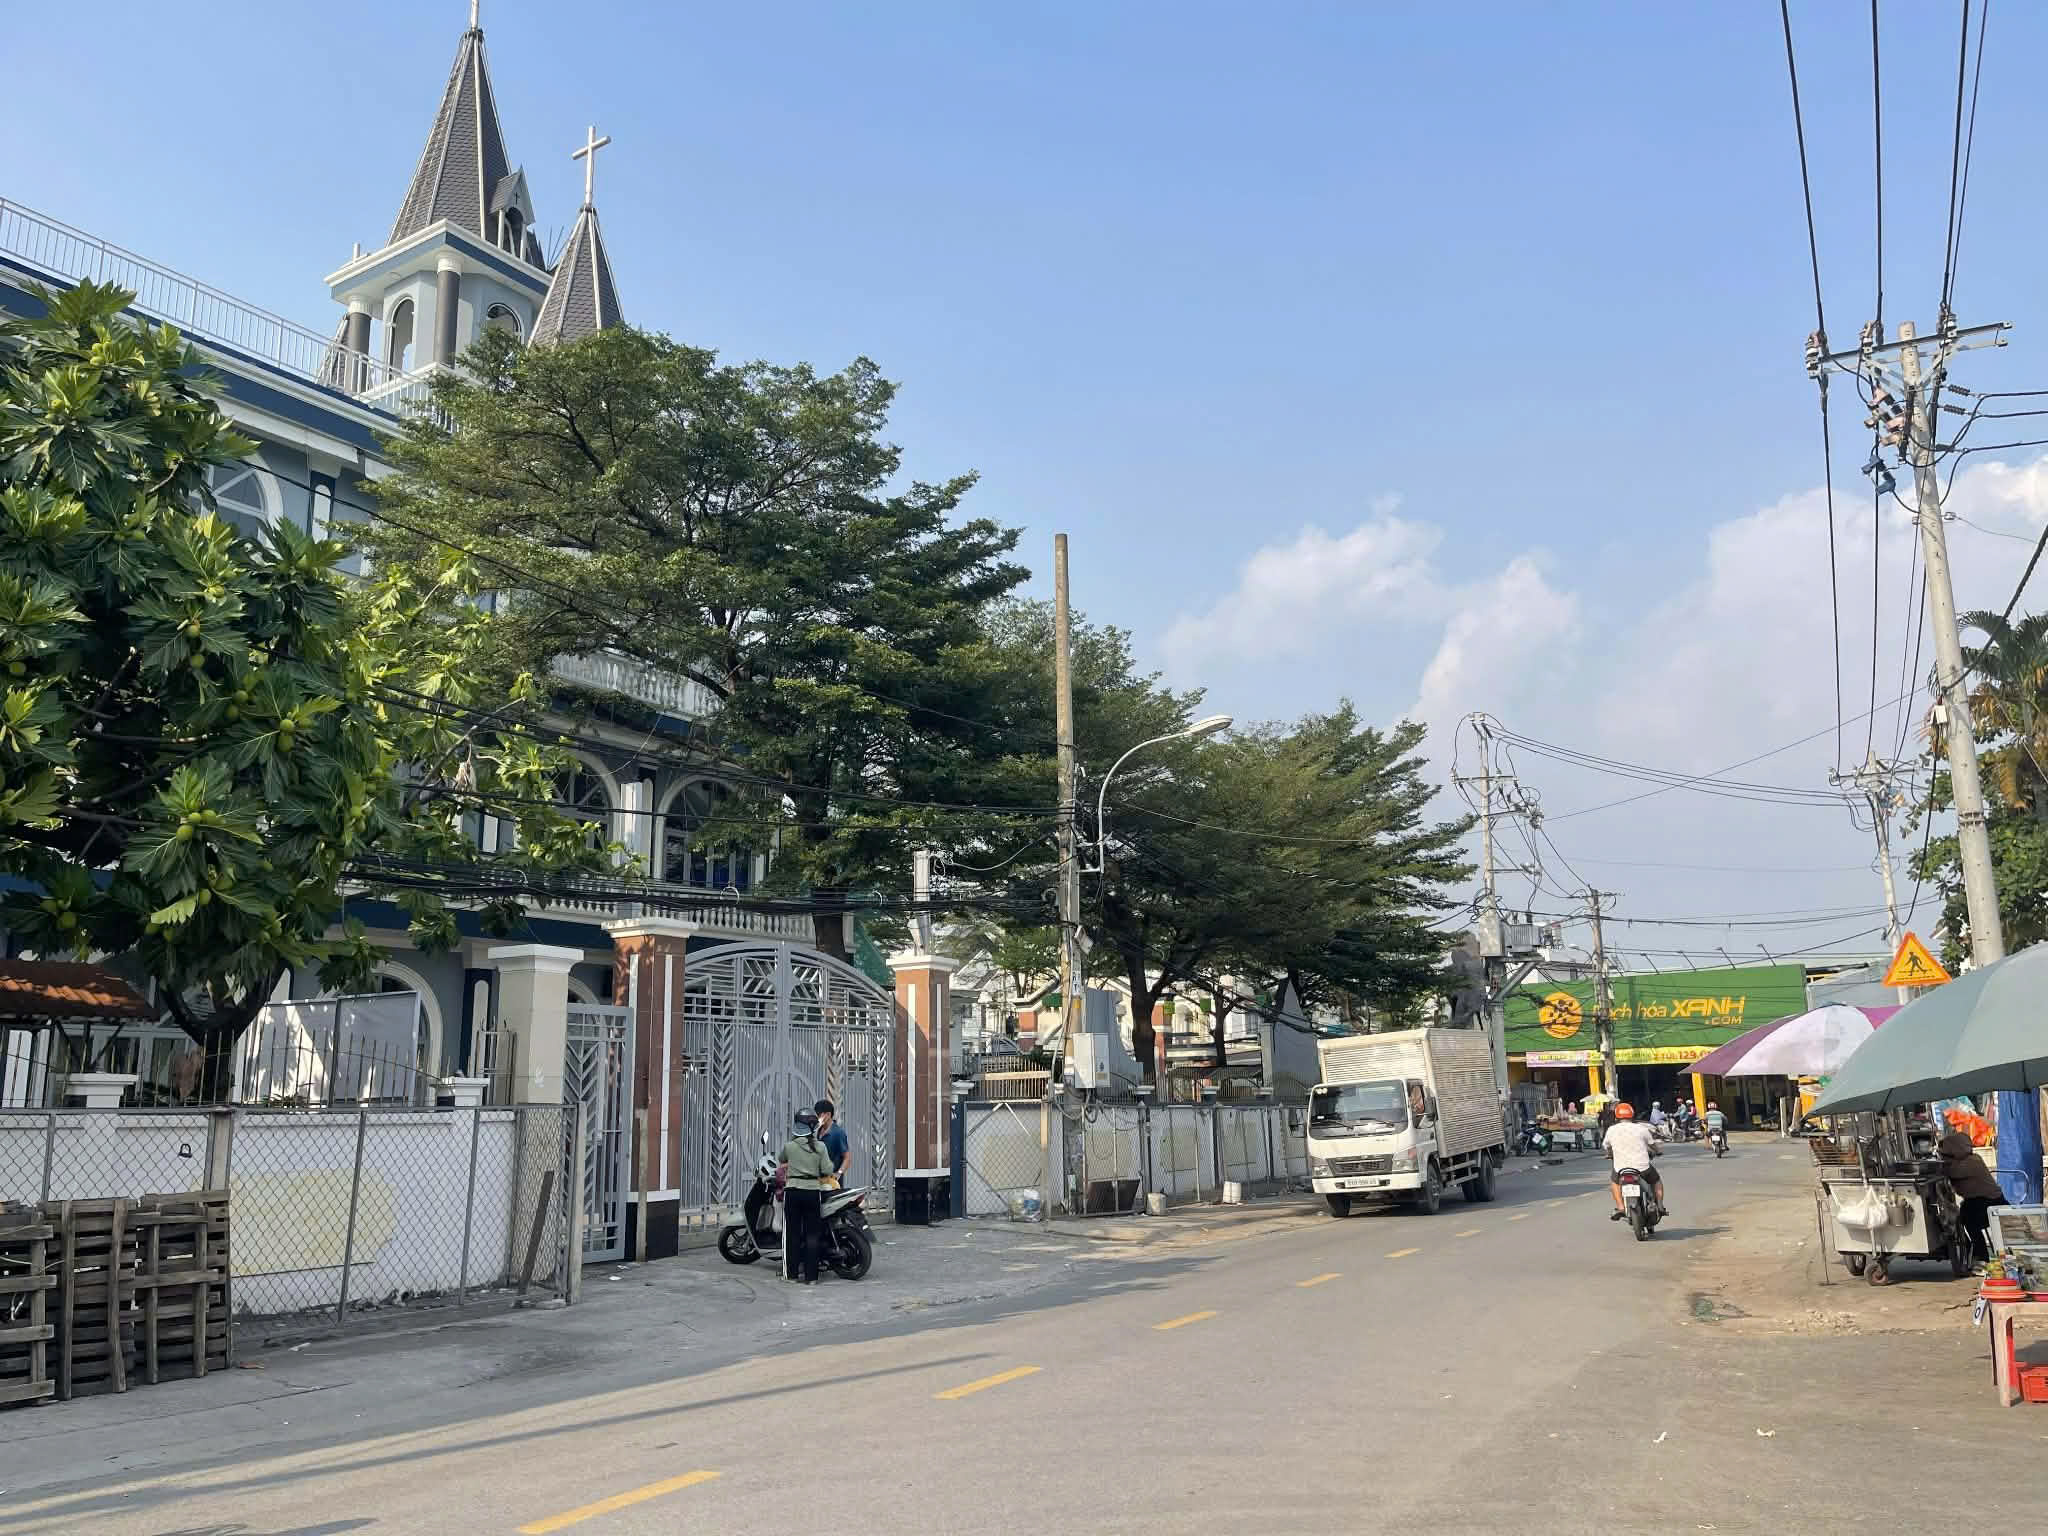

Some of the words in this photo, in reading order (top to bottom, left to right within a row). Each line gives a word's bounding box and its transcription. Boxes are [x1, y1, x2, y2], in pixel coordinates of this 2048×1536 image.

[1637, 1000, 1667, 1018] hóa
[1671, 996, 1745, 1018] XANH
[1704, 1015, 1742, 1025] .COM
